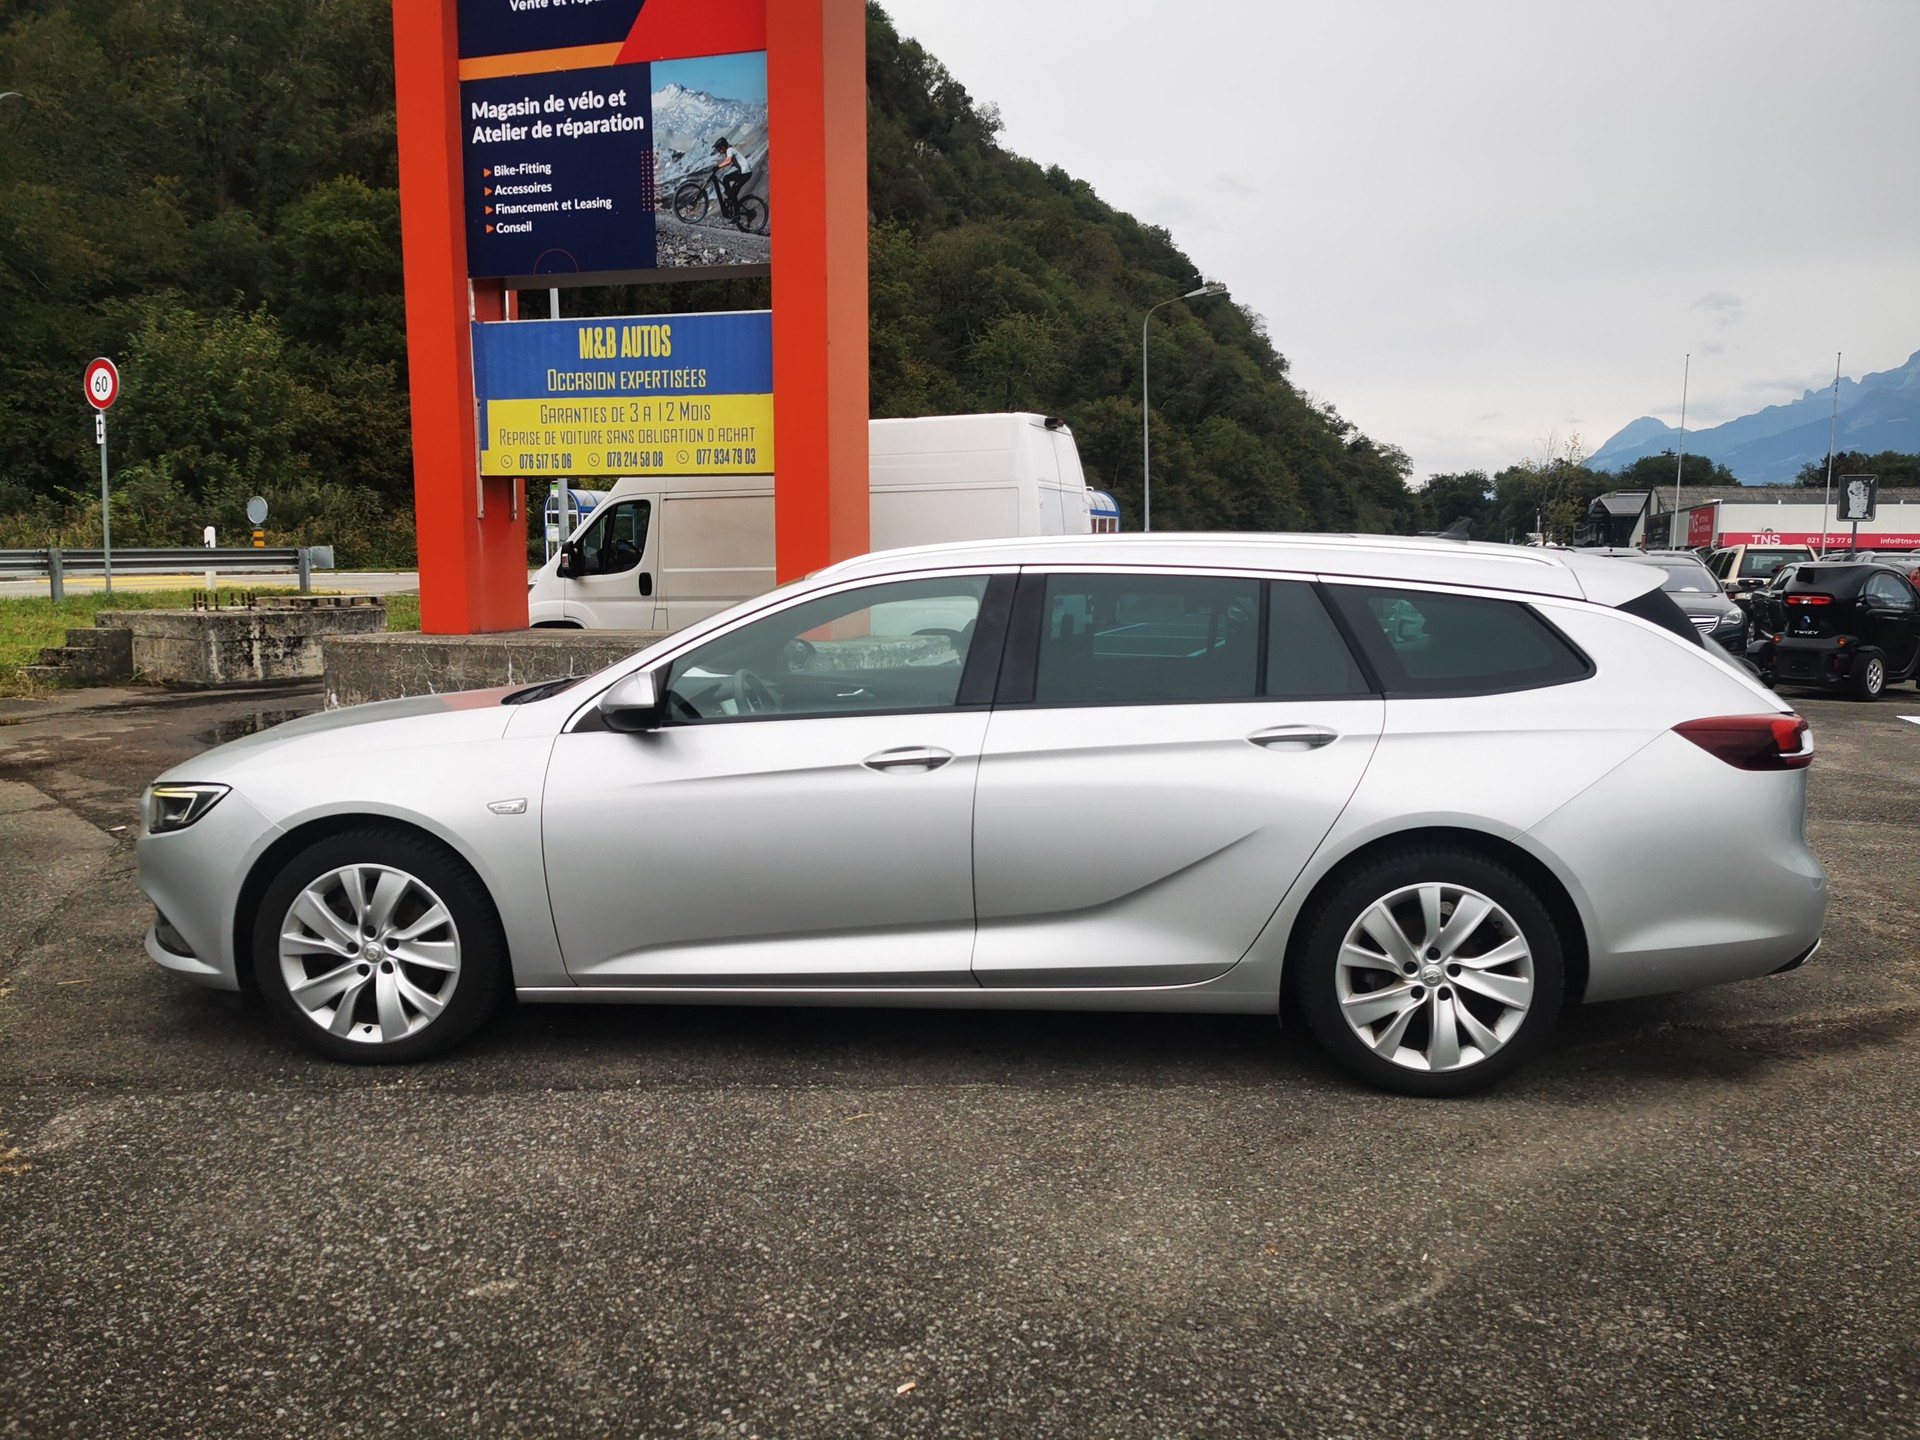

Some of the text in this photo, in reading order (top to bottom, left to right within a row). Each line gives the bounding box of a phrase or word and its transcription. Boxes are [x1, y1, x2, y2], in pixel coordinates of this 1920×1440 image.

[471, 89, 627, 121] Magasin de vélo et
[472, 113, 644, 144] Atelier de réparation
[494, 162, 552, 177] Bike-Fitting
[494, 182, 552, 196] Accessoires
[495, 196, 613, 215] Financement et Leasing
[496, 220, 533, 234] Conseil
[578, 324, 672, 360] M&B AUTOS
[95, 376, 108, 393] 60
[547, 368, 616, 392] OCCASION
[540, 404, 607, 424] GARANTIES
[611, 406, 626, 423] DE
[629, 402, 639, 423] 3
[680, 401, 711, 422] MOIS
[499, 428, 541, 446] REPRISE
[544, 431, 556, 446] DE
[560, 430, 603, 445] VOITURE
[606, 429, 635, 444] SANS
[638, 428, 704, 444] OBLIGATION
[519, 453, 572, 470] 076 517 15 06
[606, 450, 664, 468] 078 214 58 08
[696, 448, 756, 465] 077 934 79 03
[1751, 534, 1781, 545] TNS
